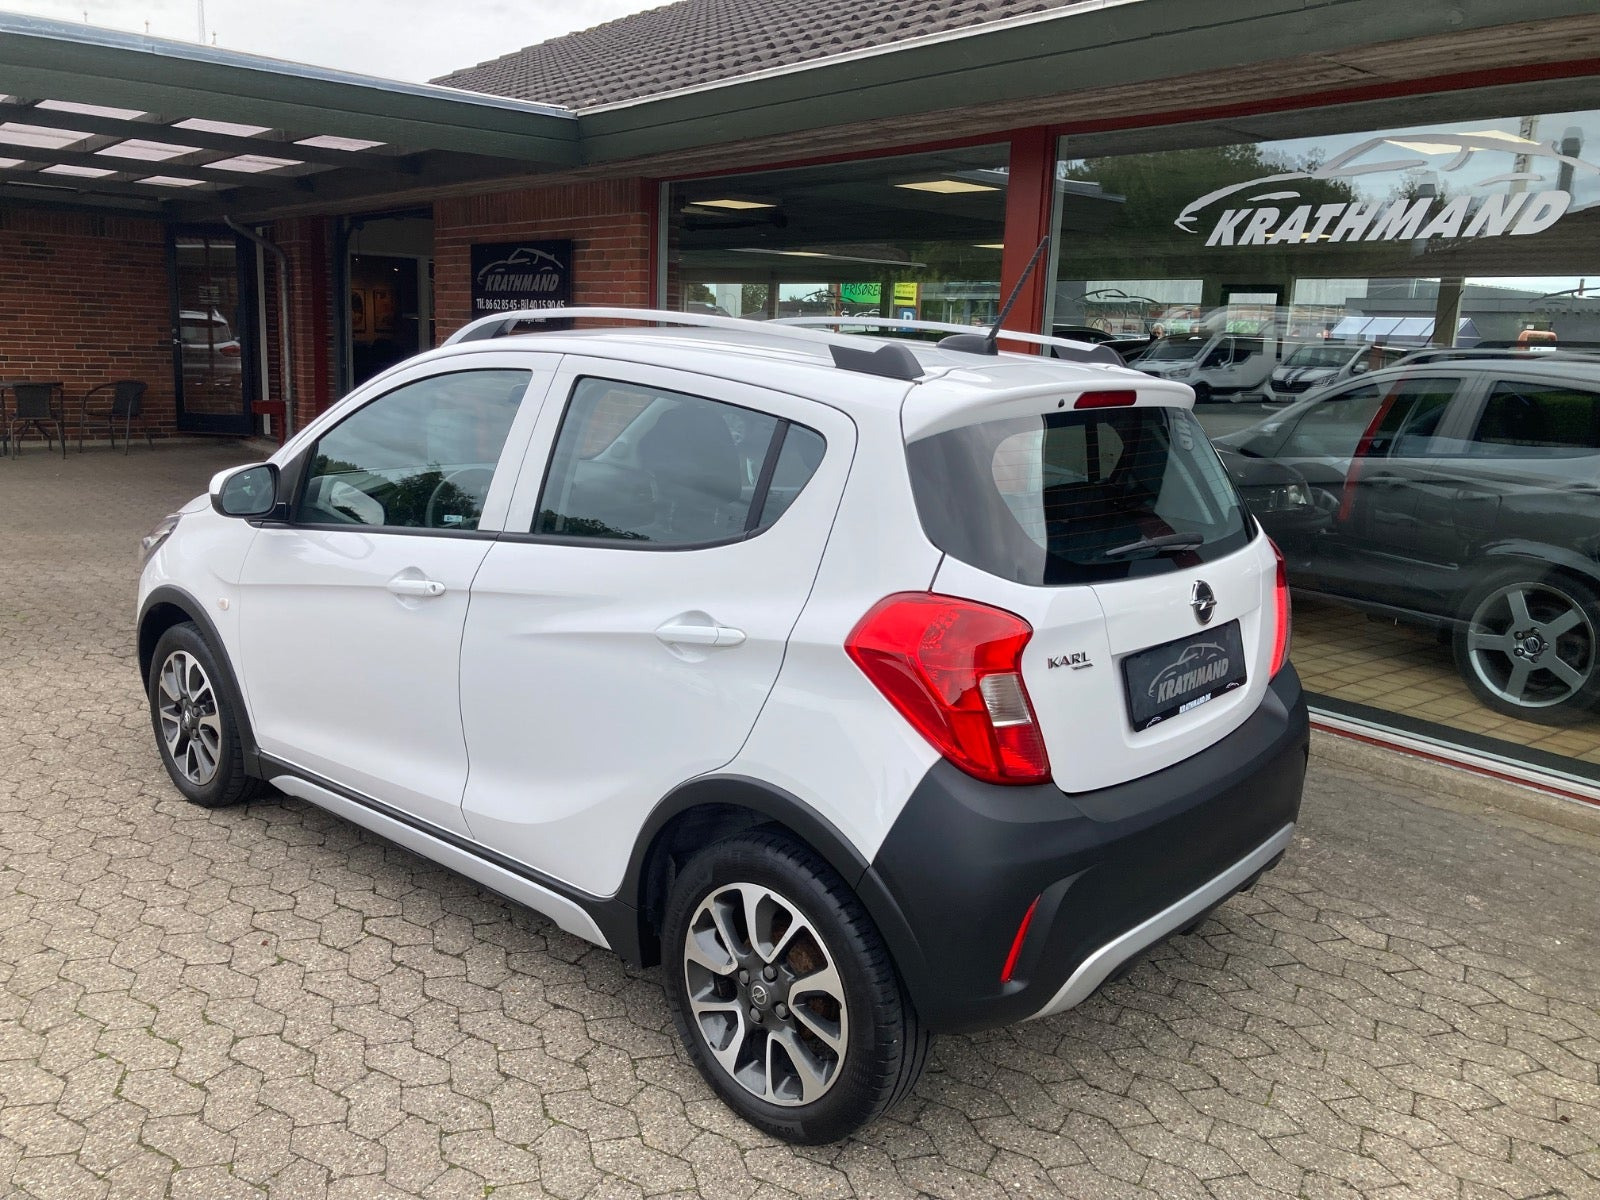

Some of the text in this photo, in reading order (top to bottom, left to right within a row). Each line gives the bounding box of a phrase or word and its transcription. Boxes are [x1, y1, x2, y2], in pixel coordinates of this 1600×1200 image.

[1204, 190, 1572, 247] KRATHMAND
[485, 273, 560, 292] KRATHMAND
[486, 298, 493, 310] 86
[493, 299, 500, 310] 62
[501, 299, 509, 310] 85
[509, 299, 517, 310] 45
[529, 299, 538, 310] 40
[538, 299, 546, 309] 15
[1047, 651, 1092, 669] KARL
[1157, 657, 1229, 704] KRATHMAND
